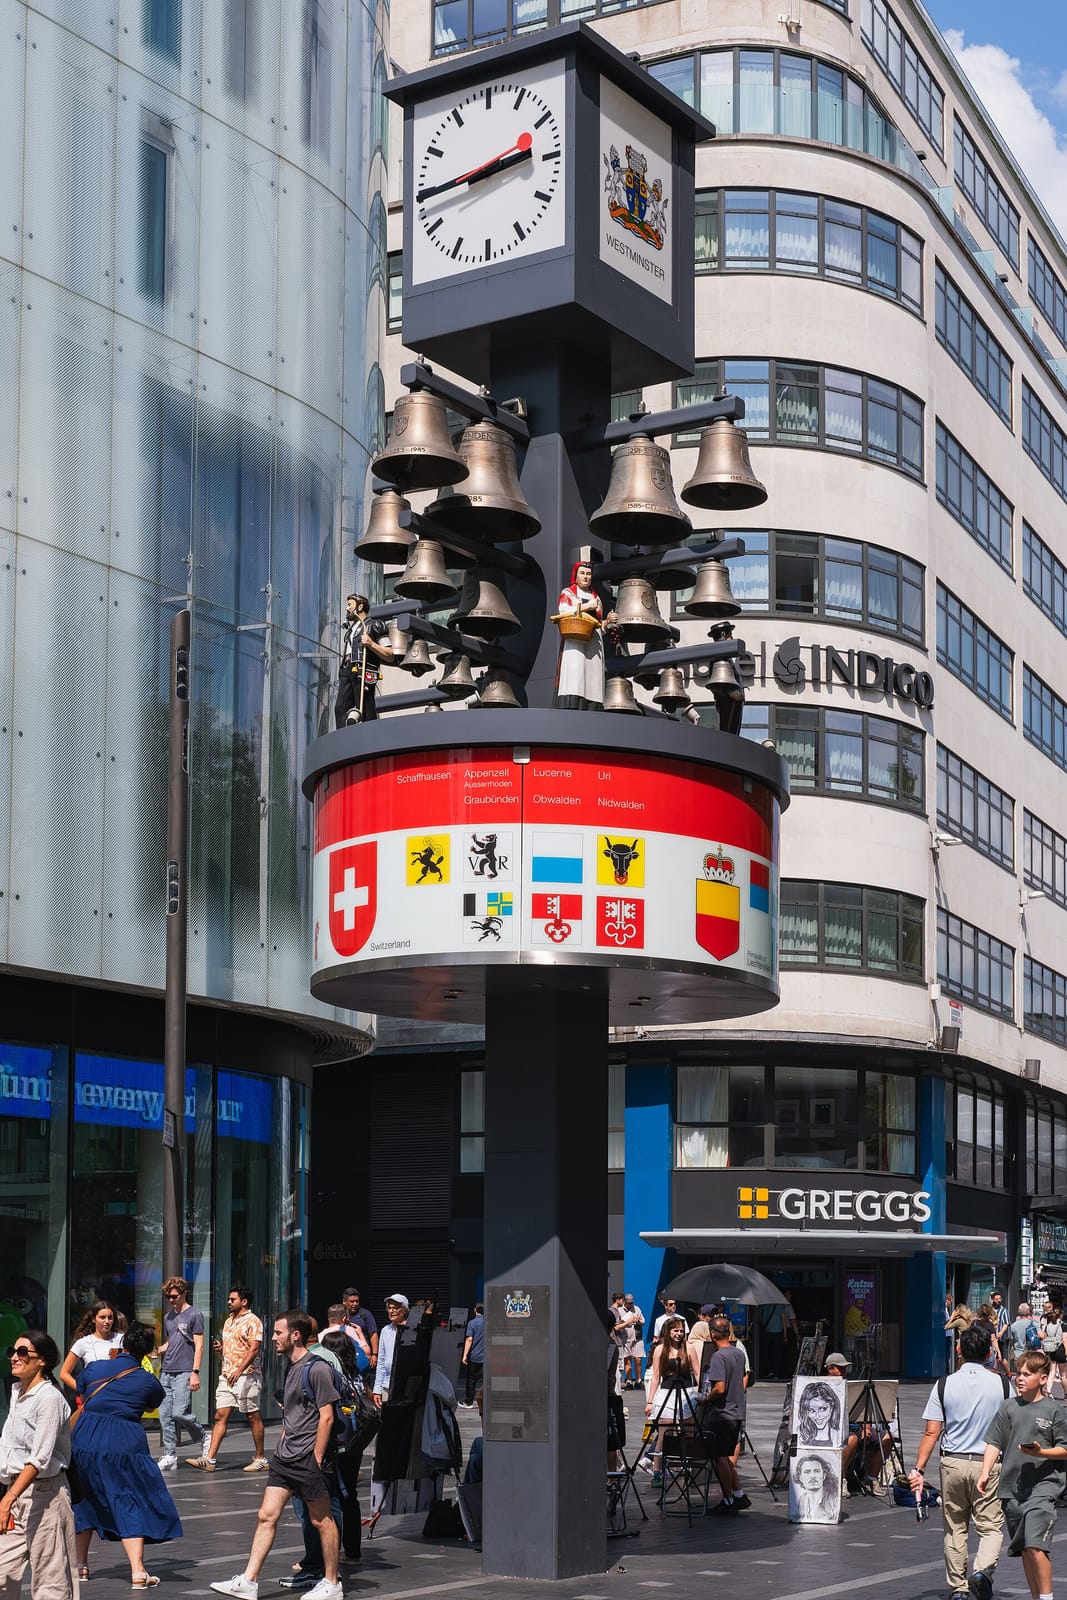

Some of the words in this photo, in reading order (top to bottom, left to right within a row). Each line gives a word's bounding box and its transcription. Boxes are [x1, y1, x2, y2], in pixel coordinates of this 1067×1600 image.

[606, 233, 665, 281] WESTMINSTER
[468, 495, 483, 503] 985
[812, 644, 934, 705] INDIGO
[396, 771, 452, 785] Schaffhausen
[463, 768, 510, 779] Appenzell
[533, 768, 572, 778] Lucerne
[597, 771, 611, 781] Uri
[463, 780, 513, 789] Ausserrhoden
[463, 794, 519, 805] Graubünden
[532, 794, 582, 805] Obwalden
[597, 797, 645, 810] Nidwalden
[370, 939, 411, 952] Switzerland
[779, 1188, 932, 1222] GREGGS
